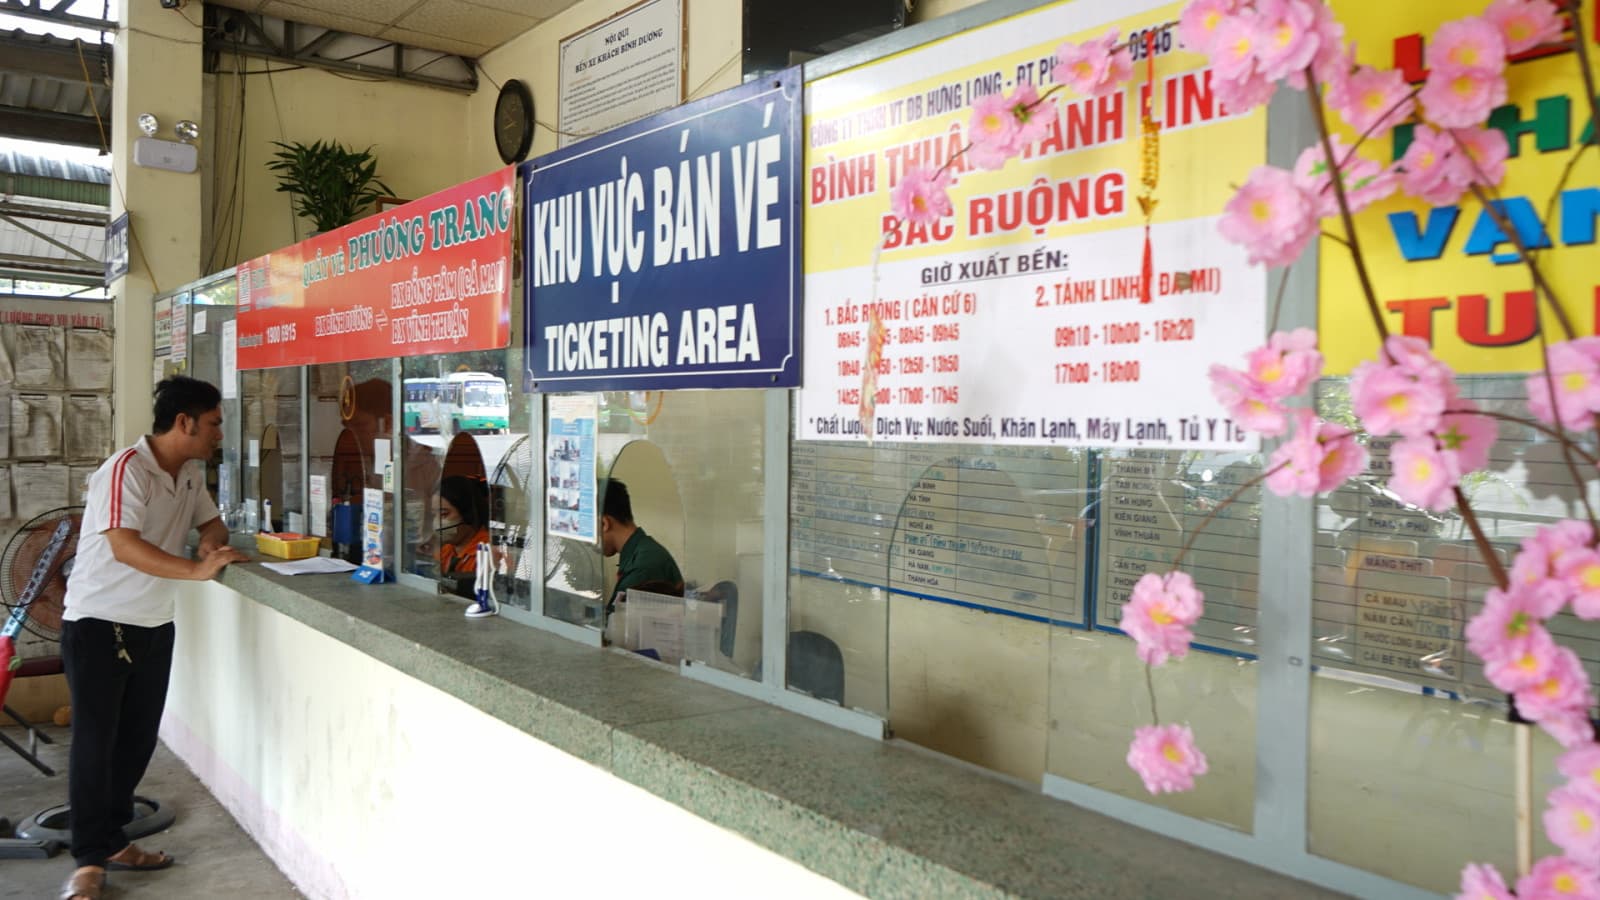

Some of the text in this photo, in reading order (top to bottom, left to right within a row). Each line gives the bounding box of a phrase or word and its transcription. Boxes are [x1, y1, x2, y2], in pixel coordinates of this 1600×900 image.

[588, 60, 596, 71] XE
[811, 68, 1251, 205] BÌNH THUẬ ÁNH LIN
[533, 101, 781, 304] KHU VỰC BÁN VÉ
[969, 173, 1124, 237] RUỘNG
[348, 216, 425, 273] PHƯƠNG
[429, 186, 512, 250] TRANG
[921, 246, 1069, 285] GIỜ XUẤT BẾN:
[1035, 286, 1049, 308] 2.
[1054, 276, 1096, 306] TÁNH
[1101, 276, 1140, 302] LINH
[432, 303, 469, 344] THUẬN
[825, 308, 834, 326] 1.
[1055, 318, 1194, 348] 09h10 10h00 16h20
[266, 325, 280, 344] 1900
[544, 303, 761, 372] TICKETING AREA
[899, 325, 925, 345] 08h45
[932, 323, 960, 343] 09h45
[899, 357, 924, 374] 12h50
[932, 354, 960, 373] 13h50
[1055, 360, 1141, 384] 17h00 18h00
[899, 387, 924, 404] 17h00
[932, 386, 959, 404] 17h45
[816, 413, 839, 434] Chất
[876, 416, 902, 440] Dịch
[905, 417, 923, 440] Vụ:
[927, 416, 959, 436] Nước
[962, 414, 996, 439] Suối,
[1000, 416, 1036, 438] Khăn
[1041, 418, 1081, 443] Lạnh,
[1086, 417, 1121, 442] Máy
[1126, 418, 1173, 445] Lạnh,
[1179, 414, 1199, 441] Tủ
[1206, 418, 1217, 442] Y
